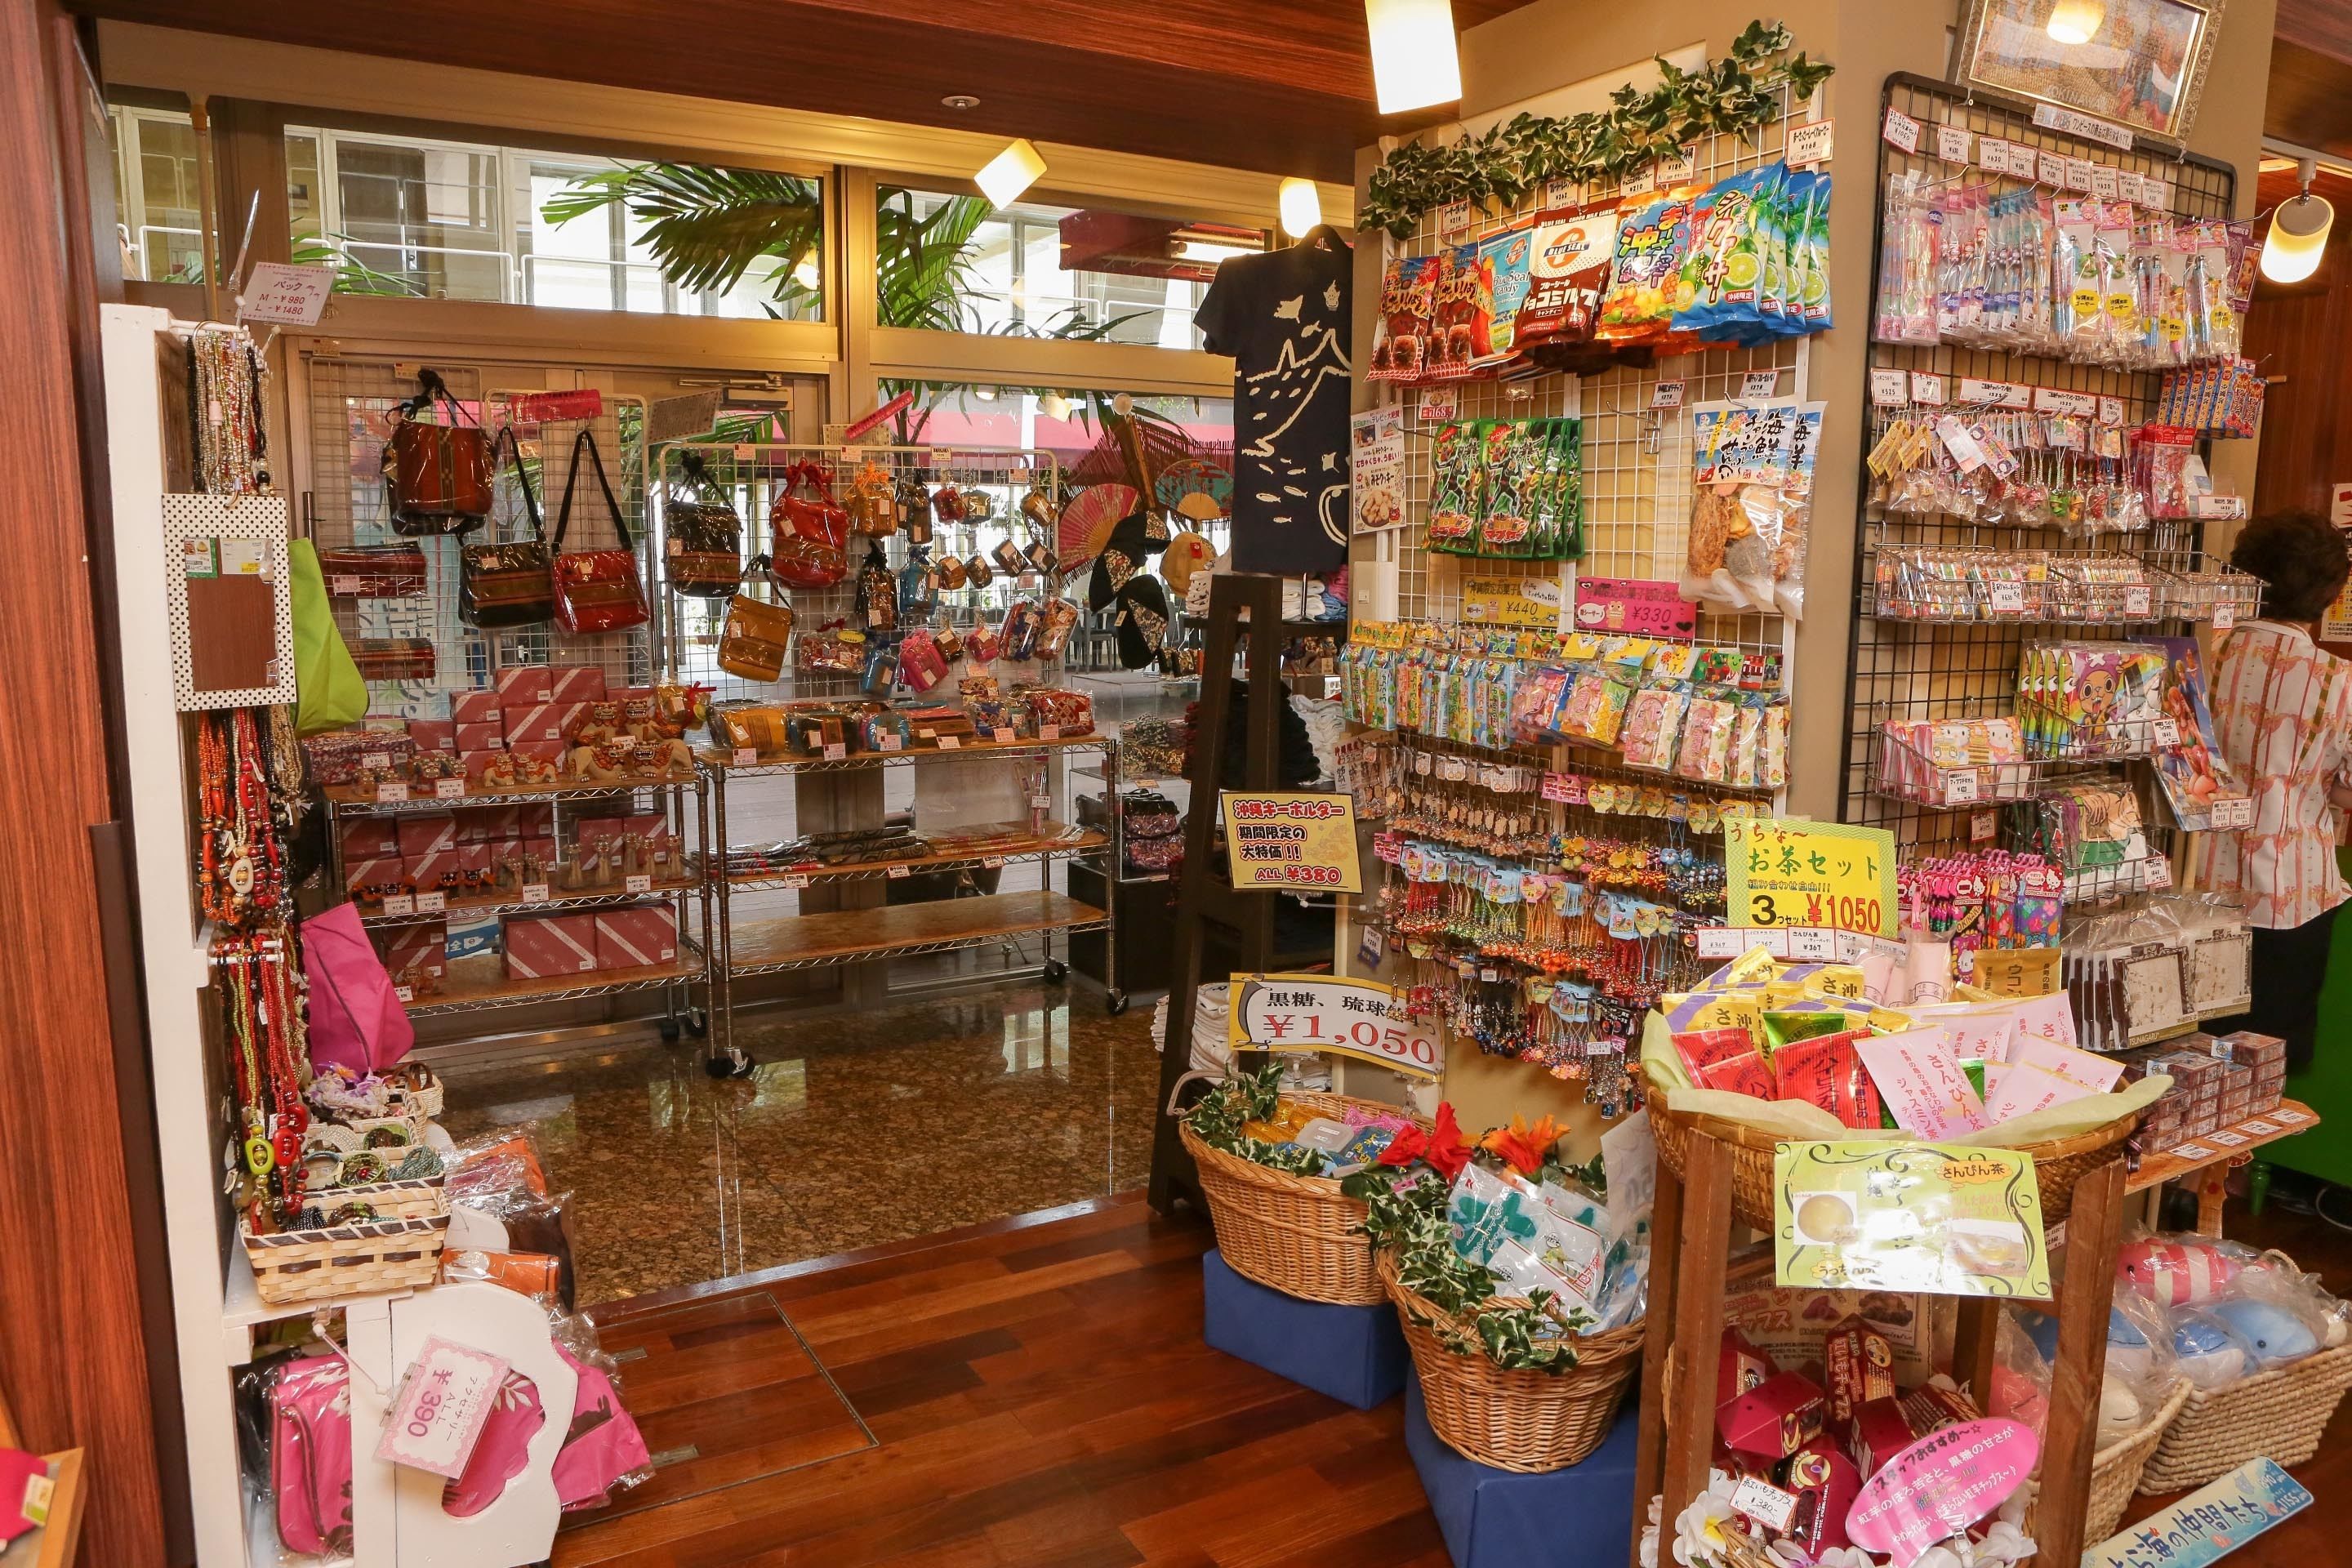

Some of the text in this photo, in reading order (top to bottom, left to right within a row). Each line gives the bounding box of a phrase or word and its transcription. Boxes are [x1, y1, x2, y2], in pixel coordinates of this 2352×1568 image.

[1548, 243, 1587, 256] BLUE SEAL
[259, 293, 270, 301] M
[280, 295, 305, 305] ¥980
[274, 305, 304, 315] ¥1480
[1506, 601, 1539, 616] ¥440
[1633, 605, 1673, 623] ¥330
[1233, 800, 1345, 818] 沖縄キーホルダー
[1237, 824, 1307, 840] 期間限定の
[1748, 845, 1878, 881] お茶セット
[1255, 866, 1342, 884] ALL ¥380
[1806, 893, 1881, 933] ¥1050
[1263, 1013, 1435, 1065] ¥1,050
[2129, 1032, 2158, 1047] TSUNAGARU
[1927, 1054, 1984, 1132] さんぴん茶
[1896, 1077, 1940, 1140] ジャスミン茶
[1943, 1162, 2006, 1179] さんぴん茶
[408, 1369, 453, 1438] ¥390
[436, 1392, 456, 1425] ALL
[447, 1376, 479, 1442] アクセサリー
[1743, 1477, 1792, 1508] 紅いもチップス
